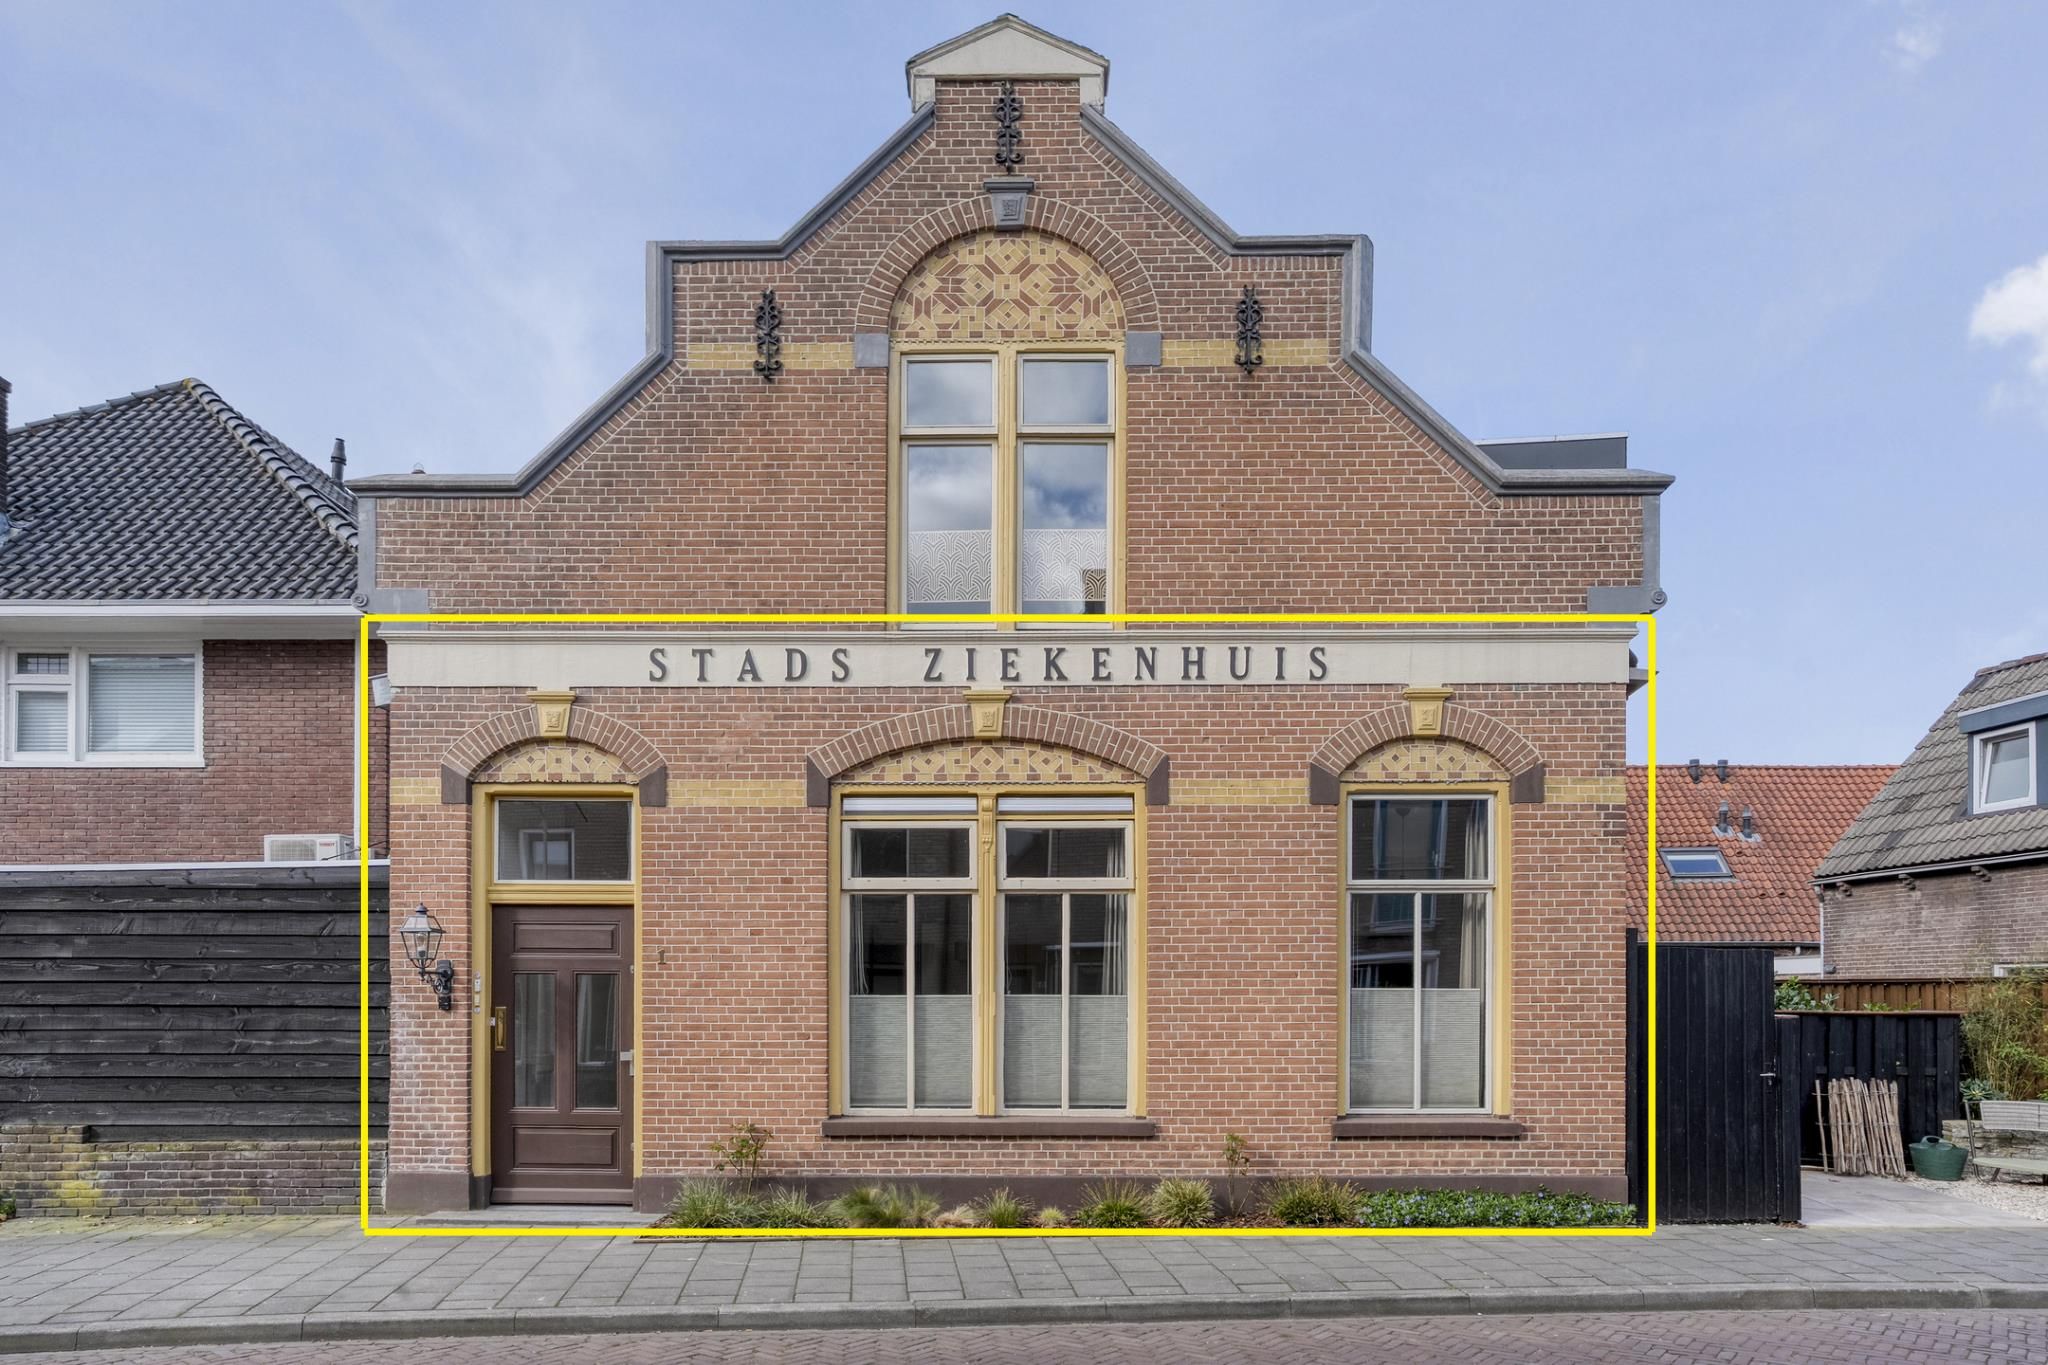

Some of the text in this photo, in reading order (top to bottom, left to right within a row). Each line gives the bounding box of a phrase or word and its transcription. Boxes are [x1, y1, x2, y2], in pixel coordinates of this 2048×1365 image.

[650, 646, 1328, 682] STADS ZIEKENHUIS
[656, 946, 666, 965] 1
